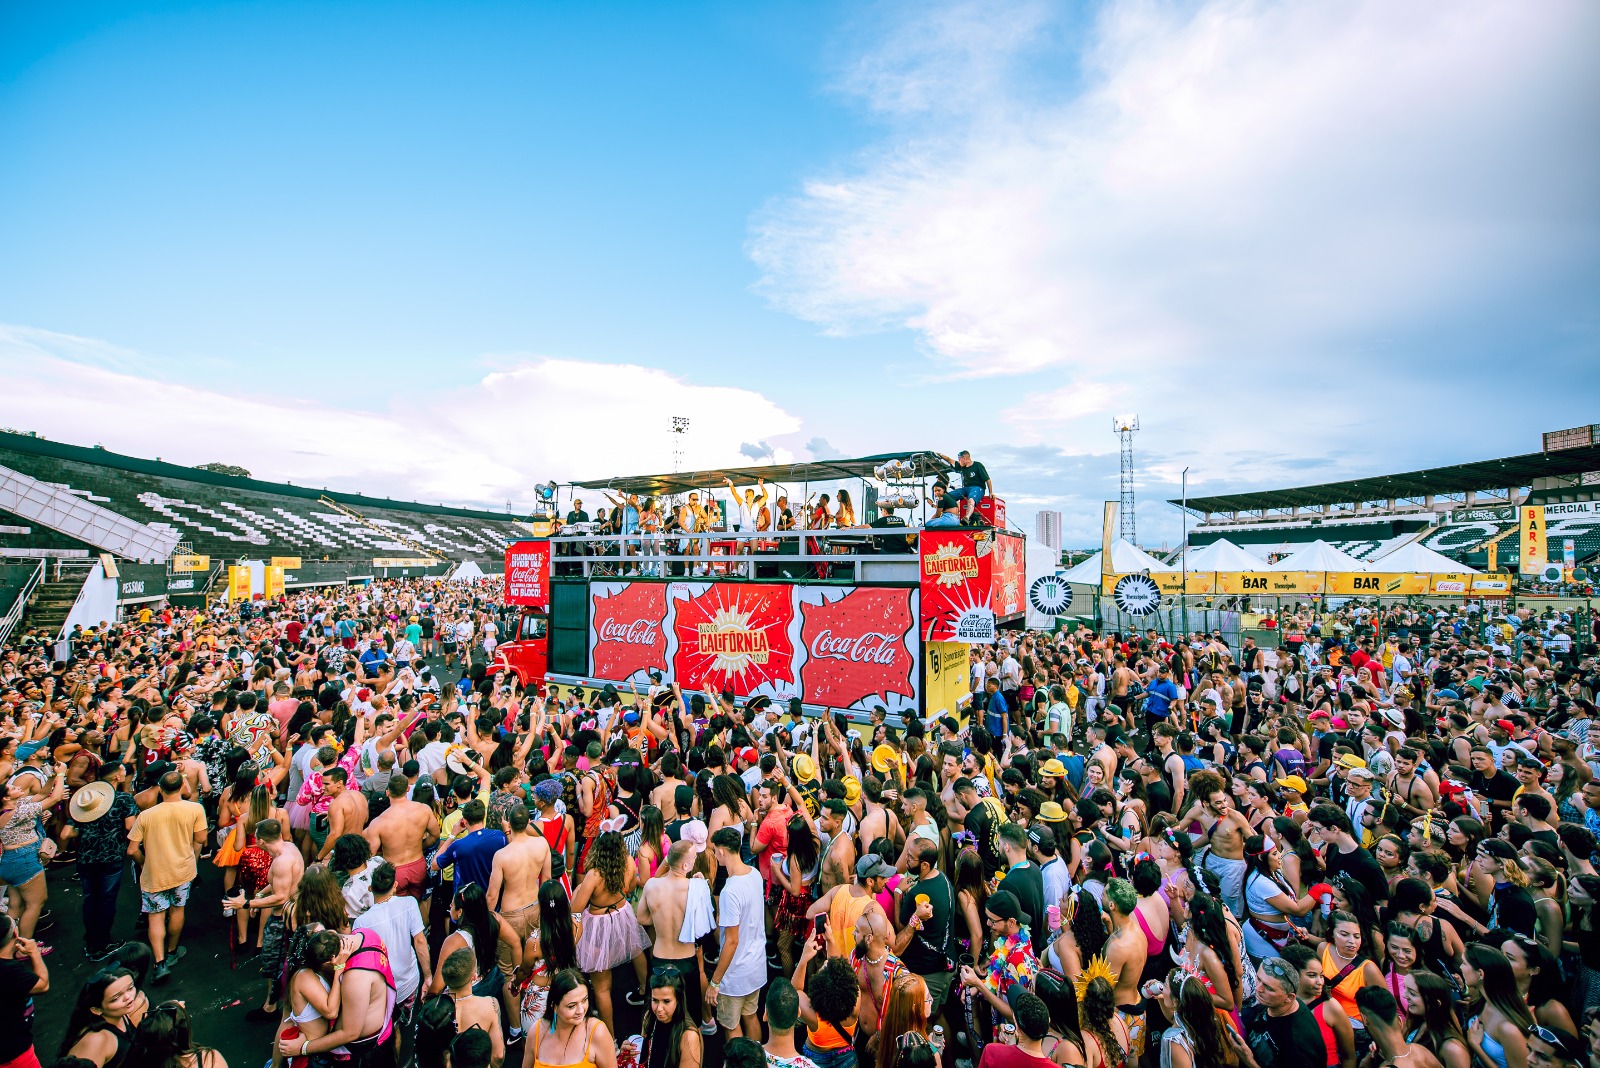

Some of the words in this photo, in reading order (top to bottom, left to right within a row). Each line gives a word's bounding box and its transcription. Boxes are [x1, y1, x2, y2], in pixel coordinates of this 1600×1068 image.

[1544, 503, 1590, 515] MERCIAL
[1528, 509, 1537, 542] BAR
[1528, 546, 1536, 556] 2
[511, 567, 540, 582] Coca-Cola
[122, 580, 145, 593] PESSOAS
[1242, 577, 1268, 589] BAR
[1353, 577, 1380, 590] BAR
[520, 589, 541, 597] BLOCO!
[699, 624, 718, 633] BLOCO
[960, 617, 993, 629] Coca-Cola
[600, 617, 660, 645] Coca-Cola
[969, 631, 992, 639] BLOCO!
[811, 629, 902, 665] Coca-Cola
[753, 653, 768, 662] 2023
